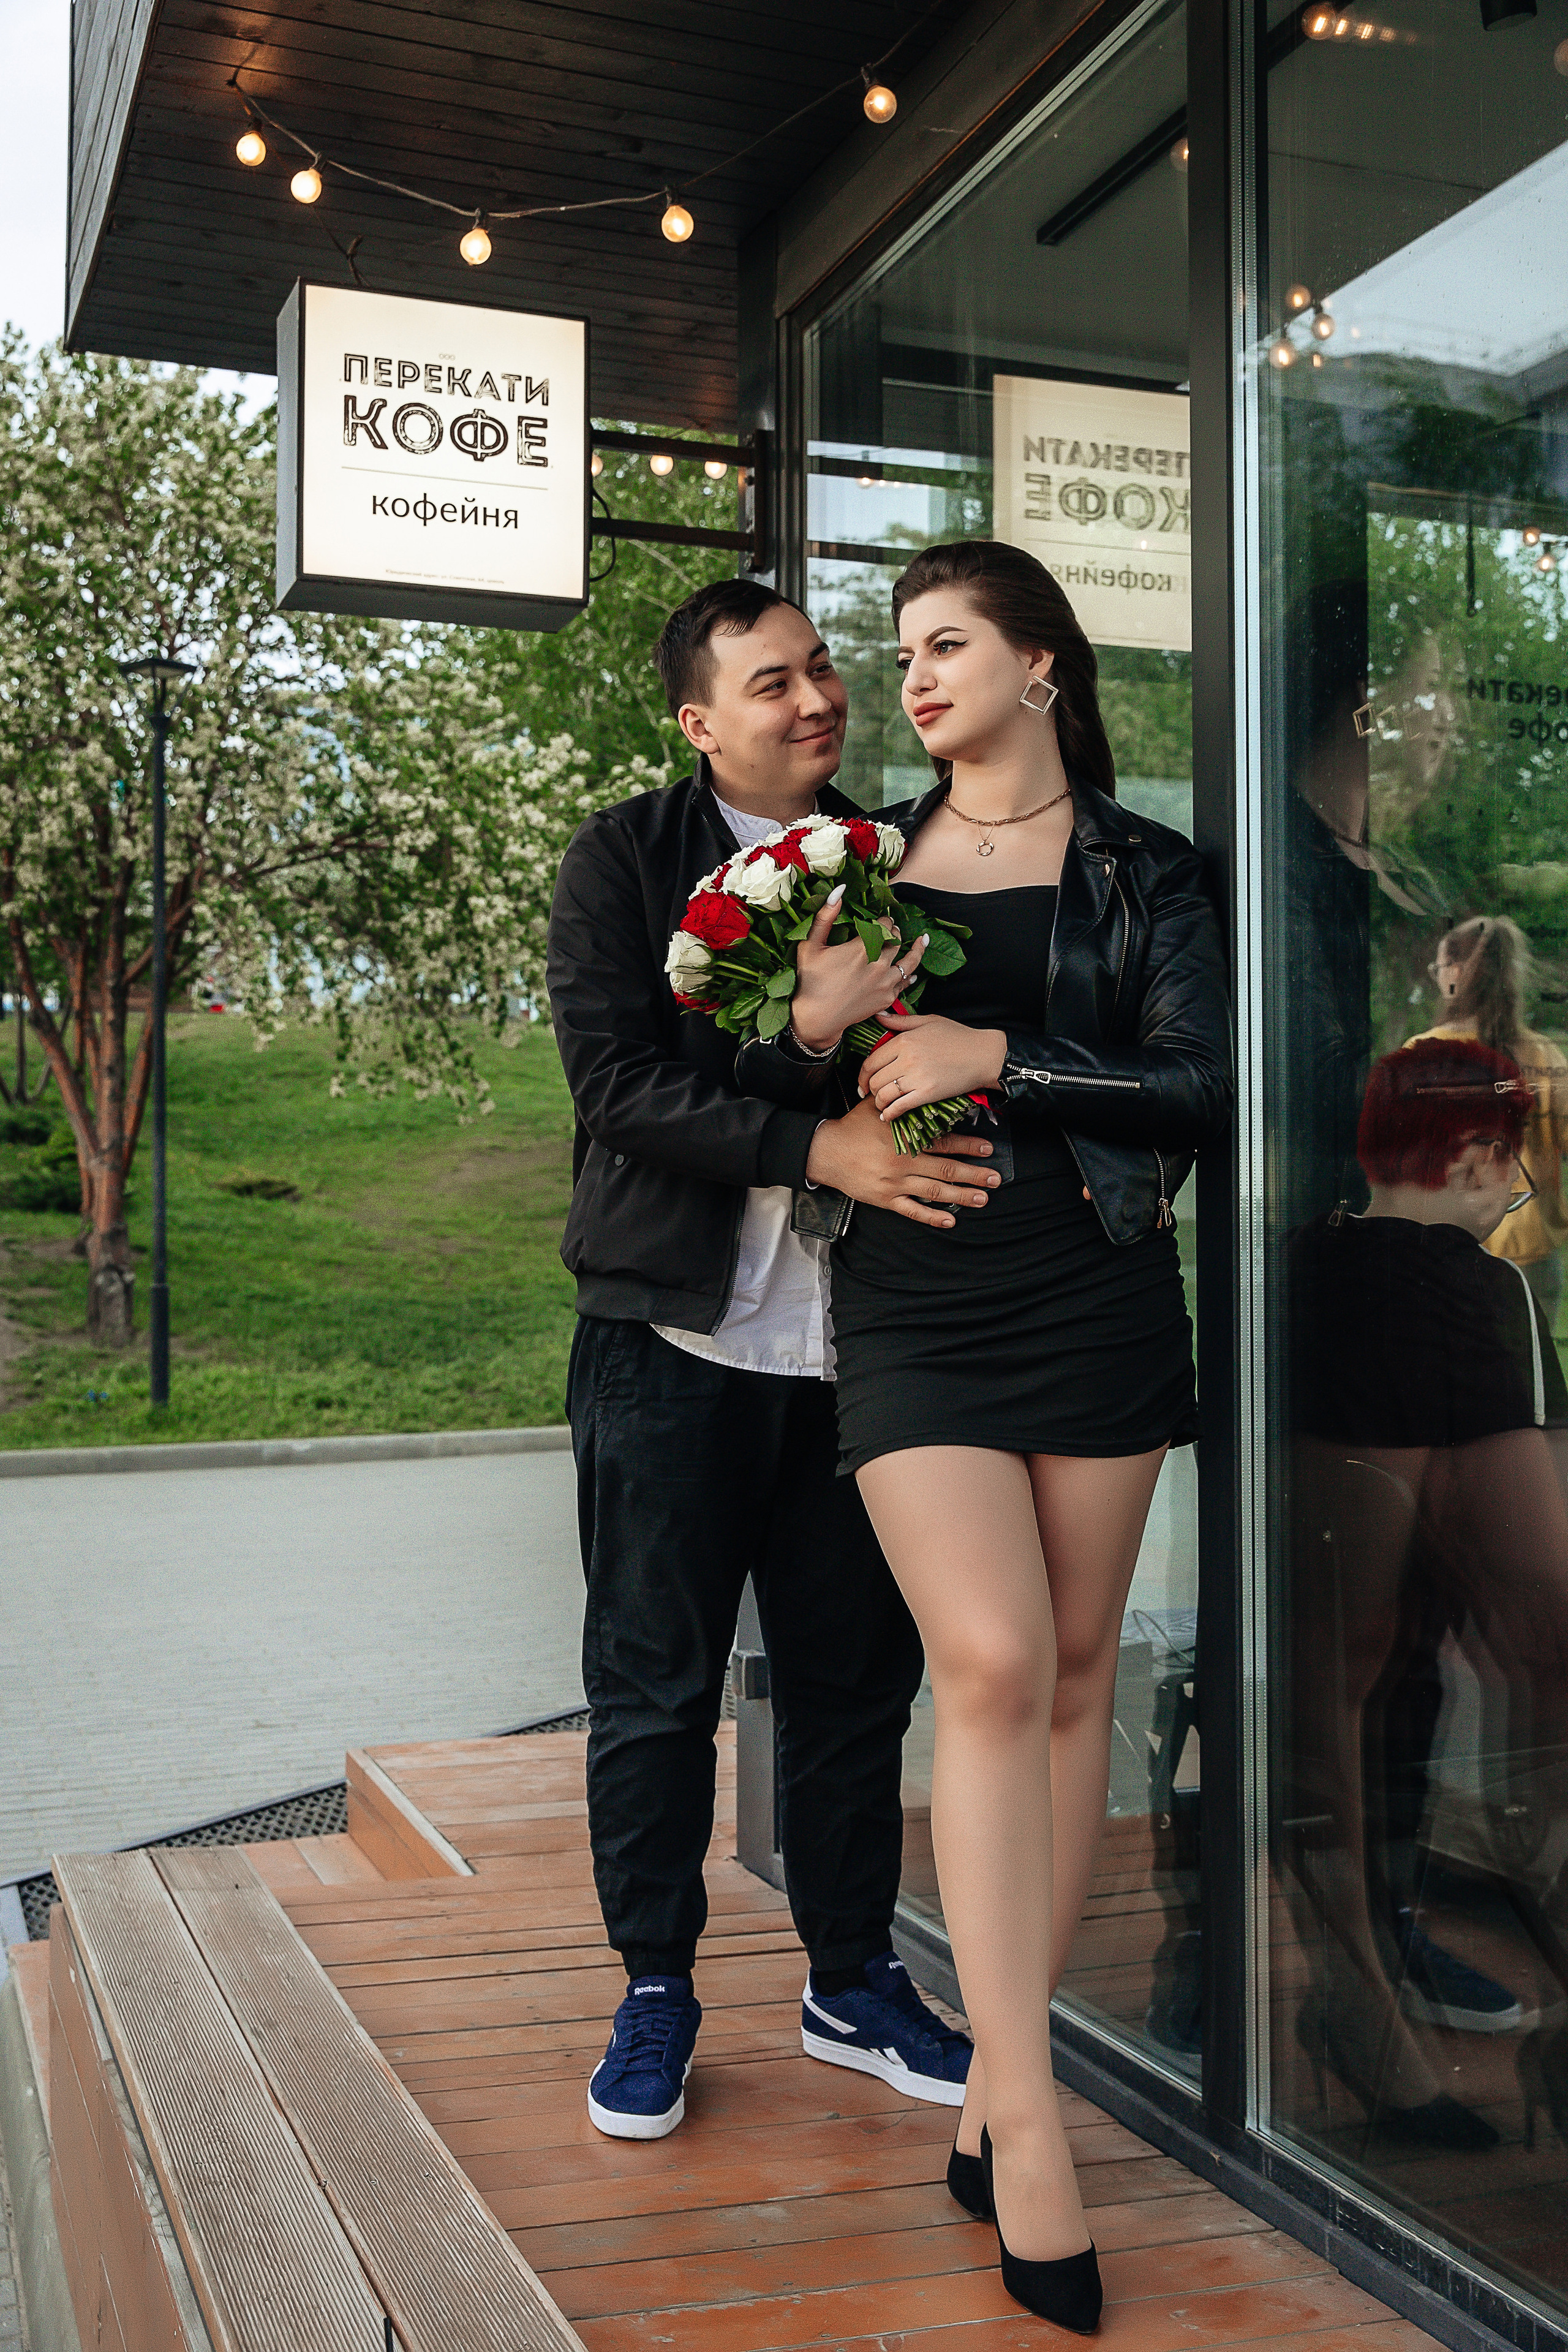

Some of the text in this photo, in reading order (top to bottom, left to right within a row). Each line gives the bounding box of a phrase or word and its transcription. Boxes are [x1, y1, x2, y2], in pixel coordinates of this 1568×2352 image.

[344, 353, 549, 406] ПЕРЕКАТИ
[343, 395, 548, 467] КОФЕ
[372, 492, 519, 529] кофейня
[635, 1985, 665, 1996] Reebok
